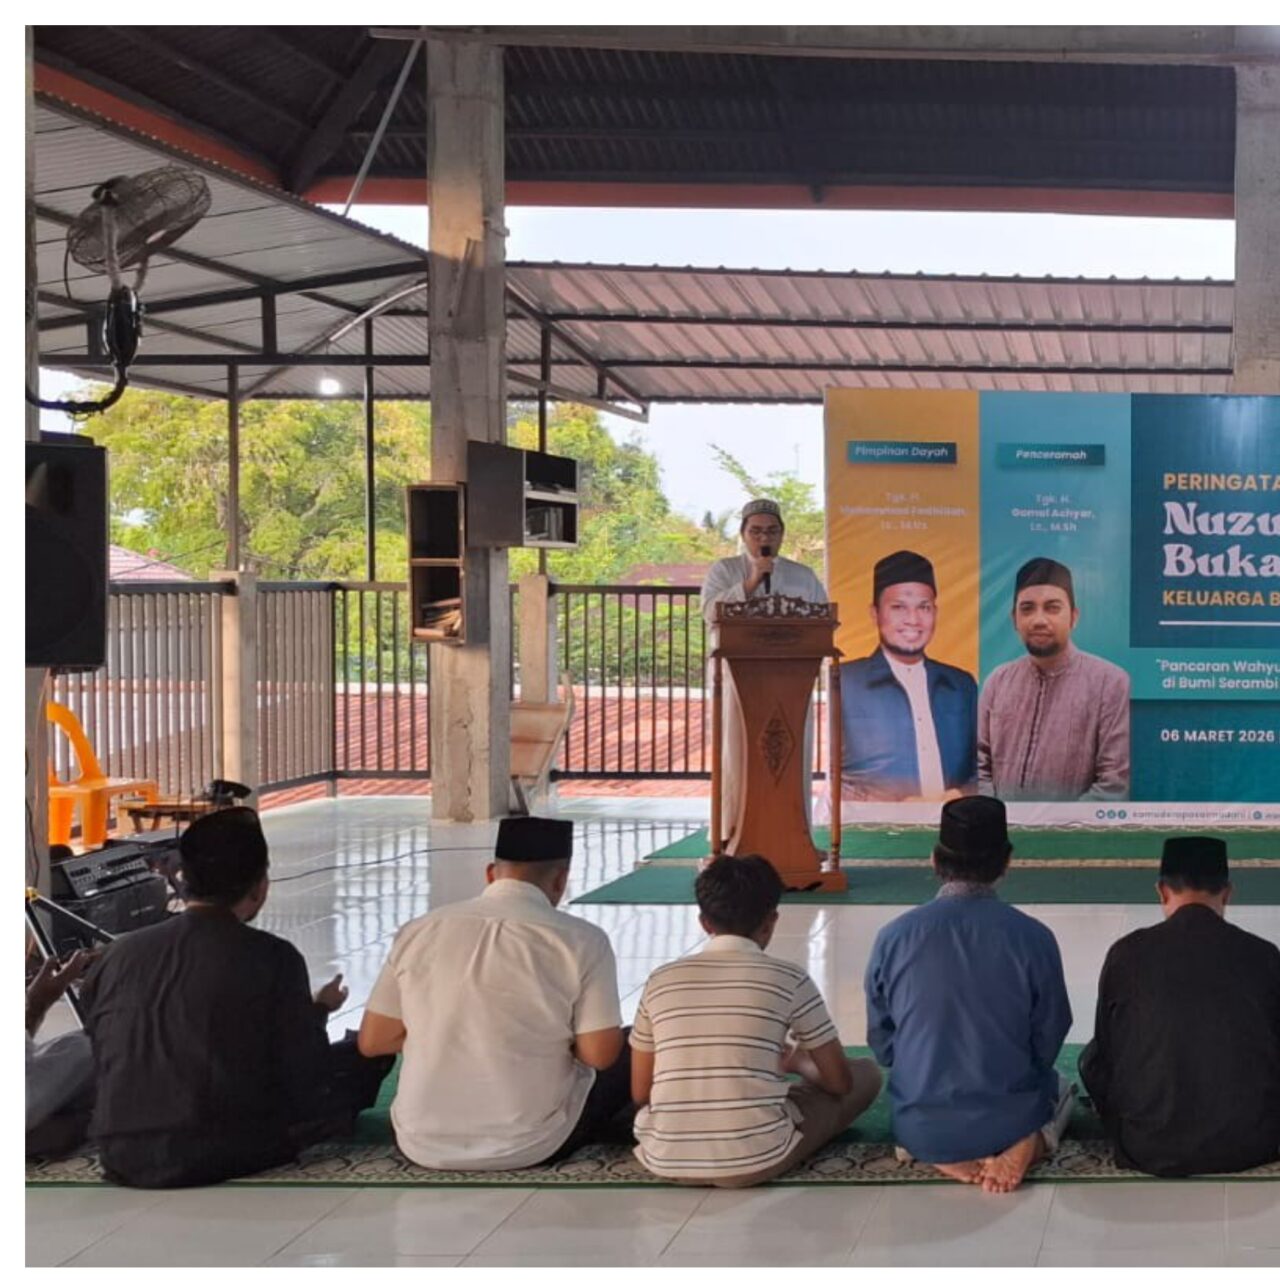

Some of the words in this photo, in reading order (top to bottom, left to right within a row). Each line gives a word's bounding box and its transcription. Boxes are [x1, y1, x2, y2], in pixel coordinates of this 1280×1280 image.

[855, 445, 909, 458] Pimpinan
[911, 446, 949, 459] Dayah
[1015, 449, 1087, 460] Penceramah
[1162, 590, 1265, 606] KELUARGA
[1162, 676, 1176, 689] di
[1179, 677, 1215, 689] Bumi
[1218, 677, 1279, 690] Serambi
[1160, 729, 1179, 742] 06
[1184, 729, 1234, 742] MARET
[1238, 729, 1275, 742] 2026
